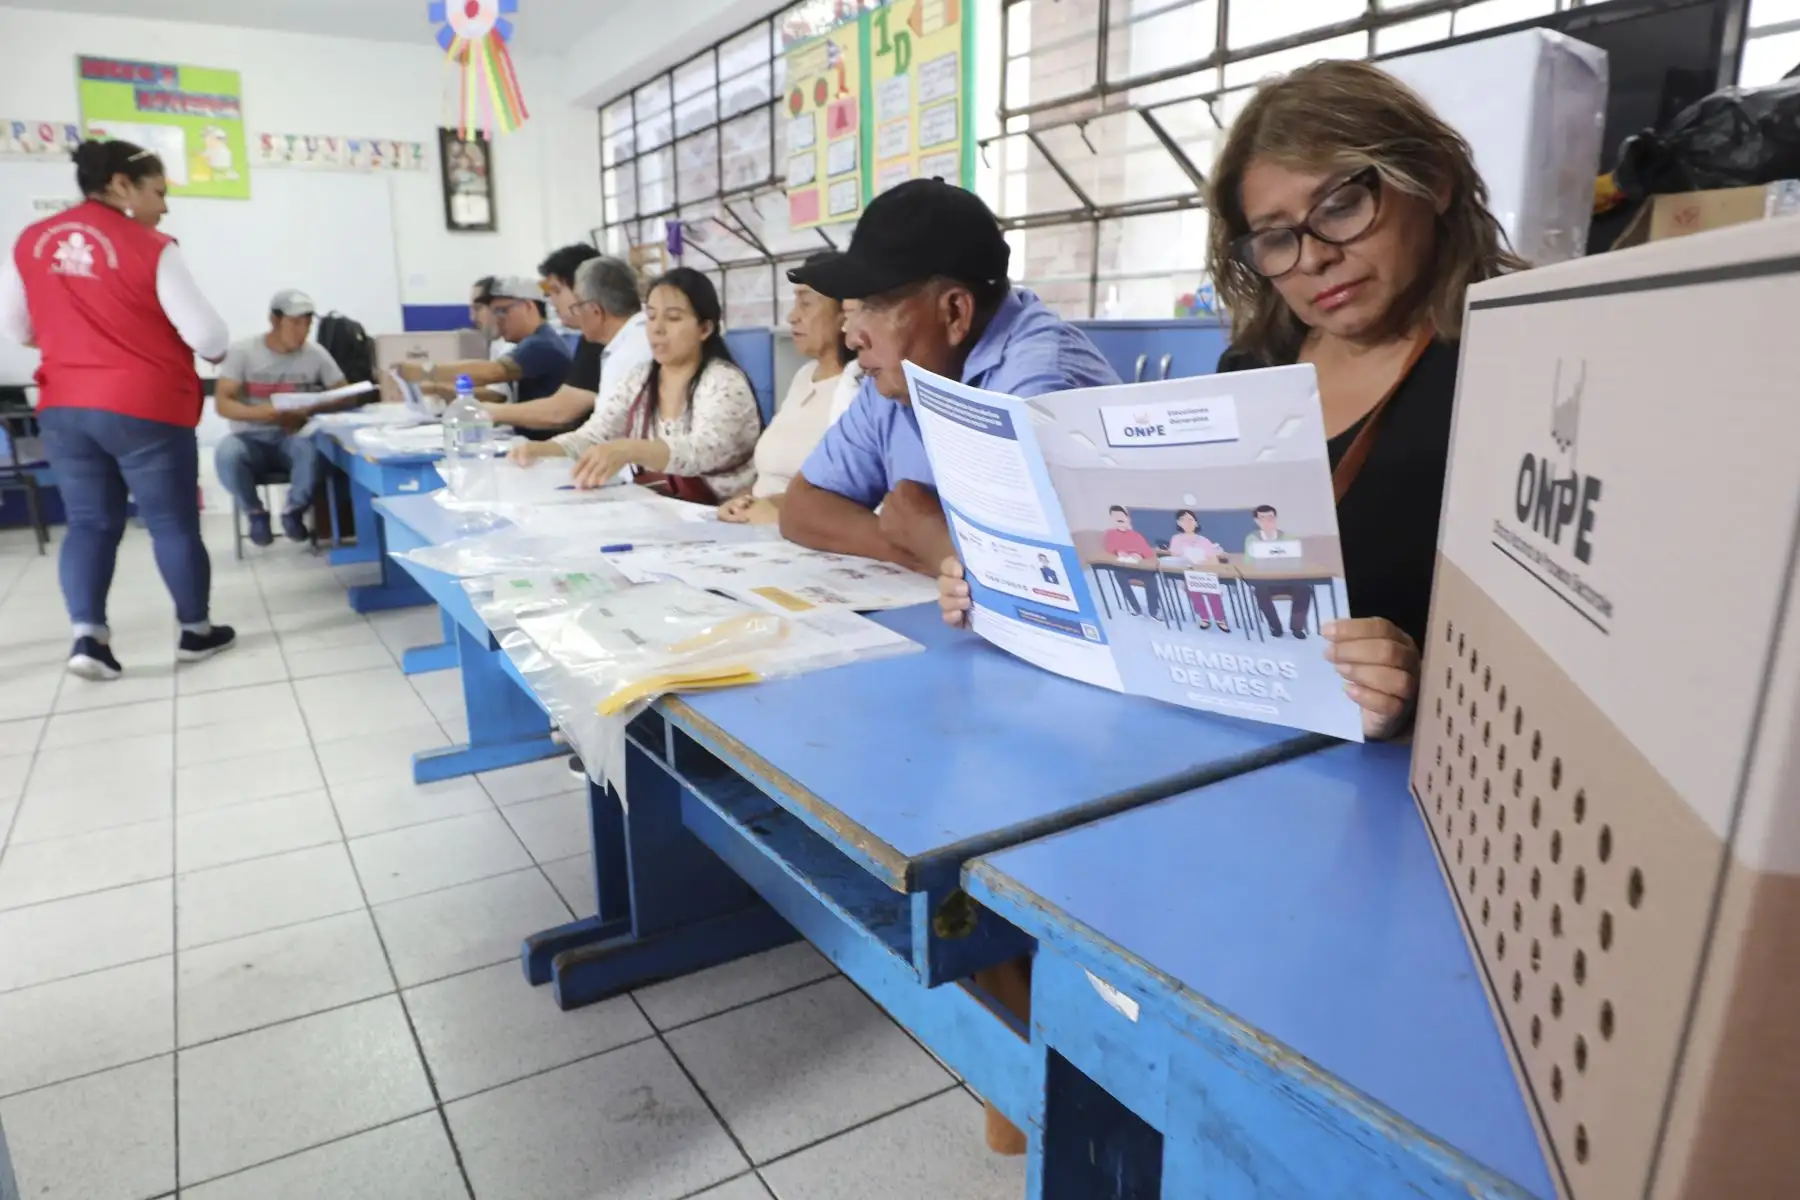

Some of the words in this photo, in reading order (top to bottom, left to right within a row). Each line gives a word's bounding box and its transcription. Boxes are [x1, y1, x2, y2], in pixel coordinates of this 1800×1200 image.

[894, 31, 911, 75] D
[1124, 425, 1166, 437] ONPE
[1516, 452, 1602, 566] ONPE
[1152, 641, 1298, 679] MIEMBROS
[1169, 665, 1205, 688] DE
[1207, 672, 1292, 702] MESA
